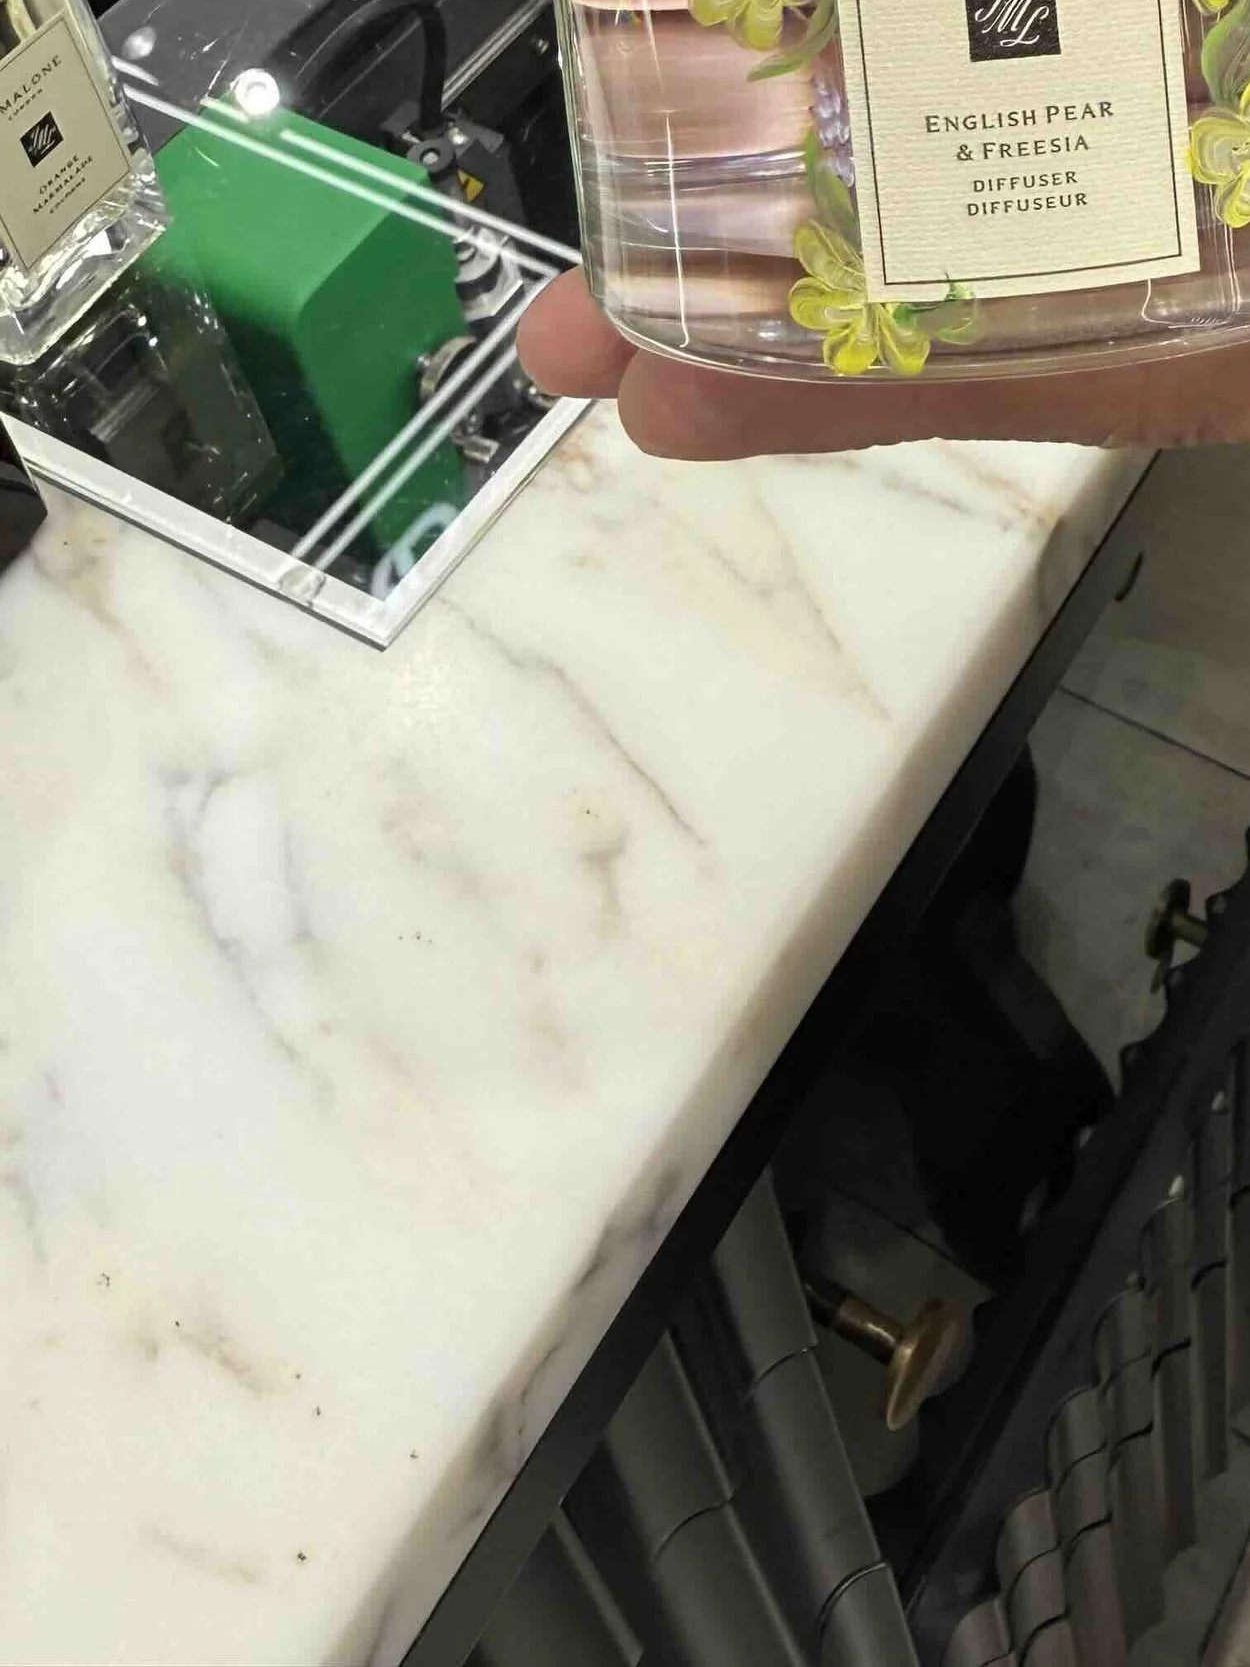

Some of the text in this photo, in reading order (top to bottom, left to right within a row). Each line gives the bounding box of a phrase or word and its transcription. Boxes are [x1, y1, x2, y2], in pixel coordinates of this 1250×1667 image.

[925, 101, 1114, 133] ENGLISH PEAR
[956, 134, 1089, 162] & FREESIA
[973, 171, 1078, 193] DIFFUSER
[967, 192, 1088, 217] DIFFUSEUR
